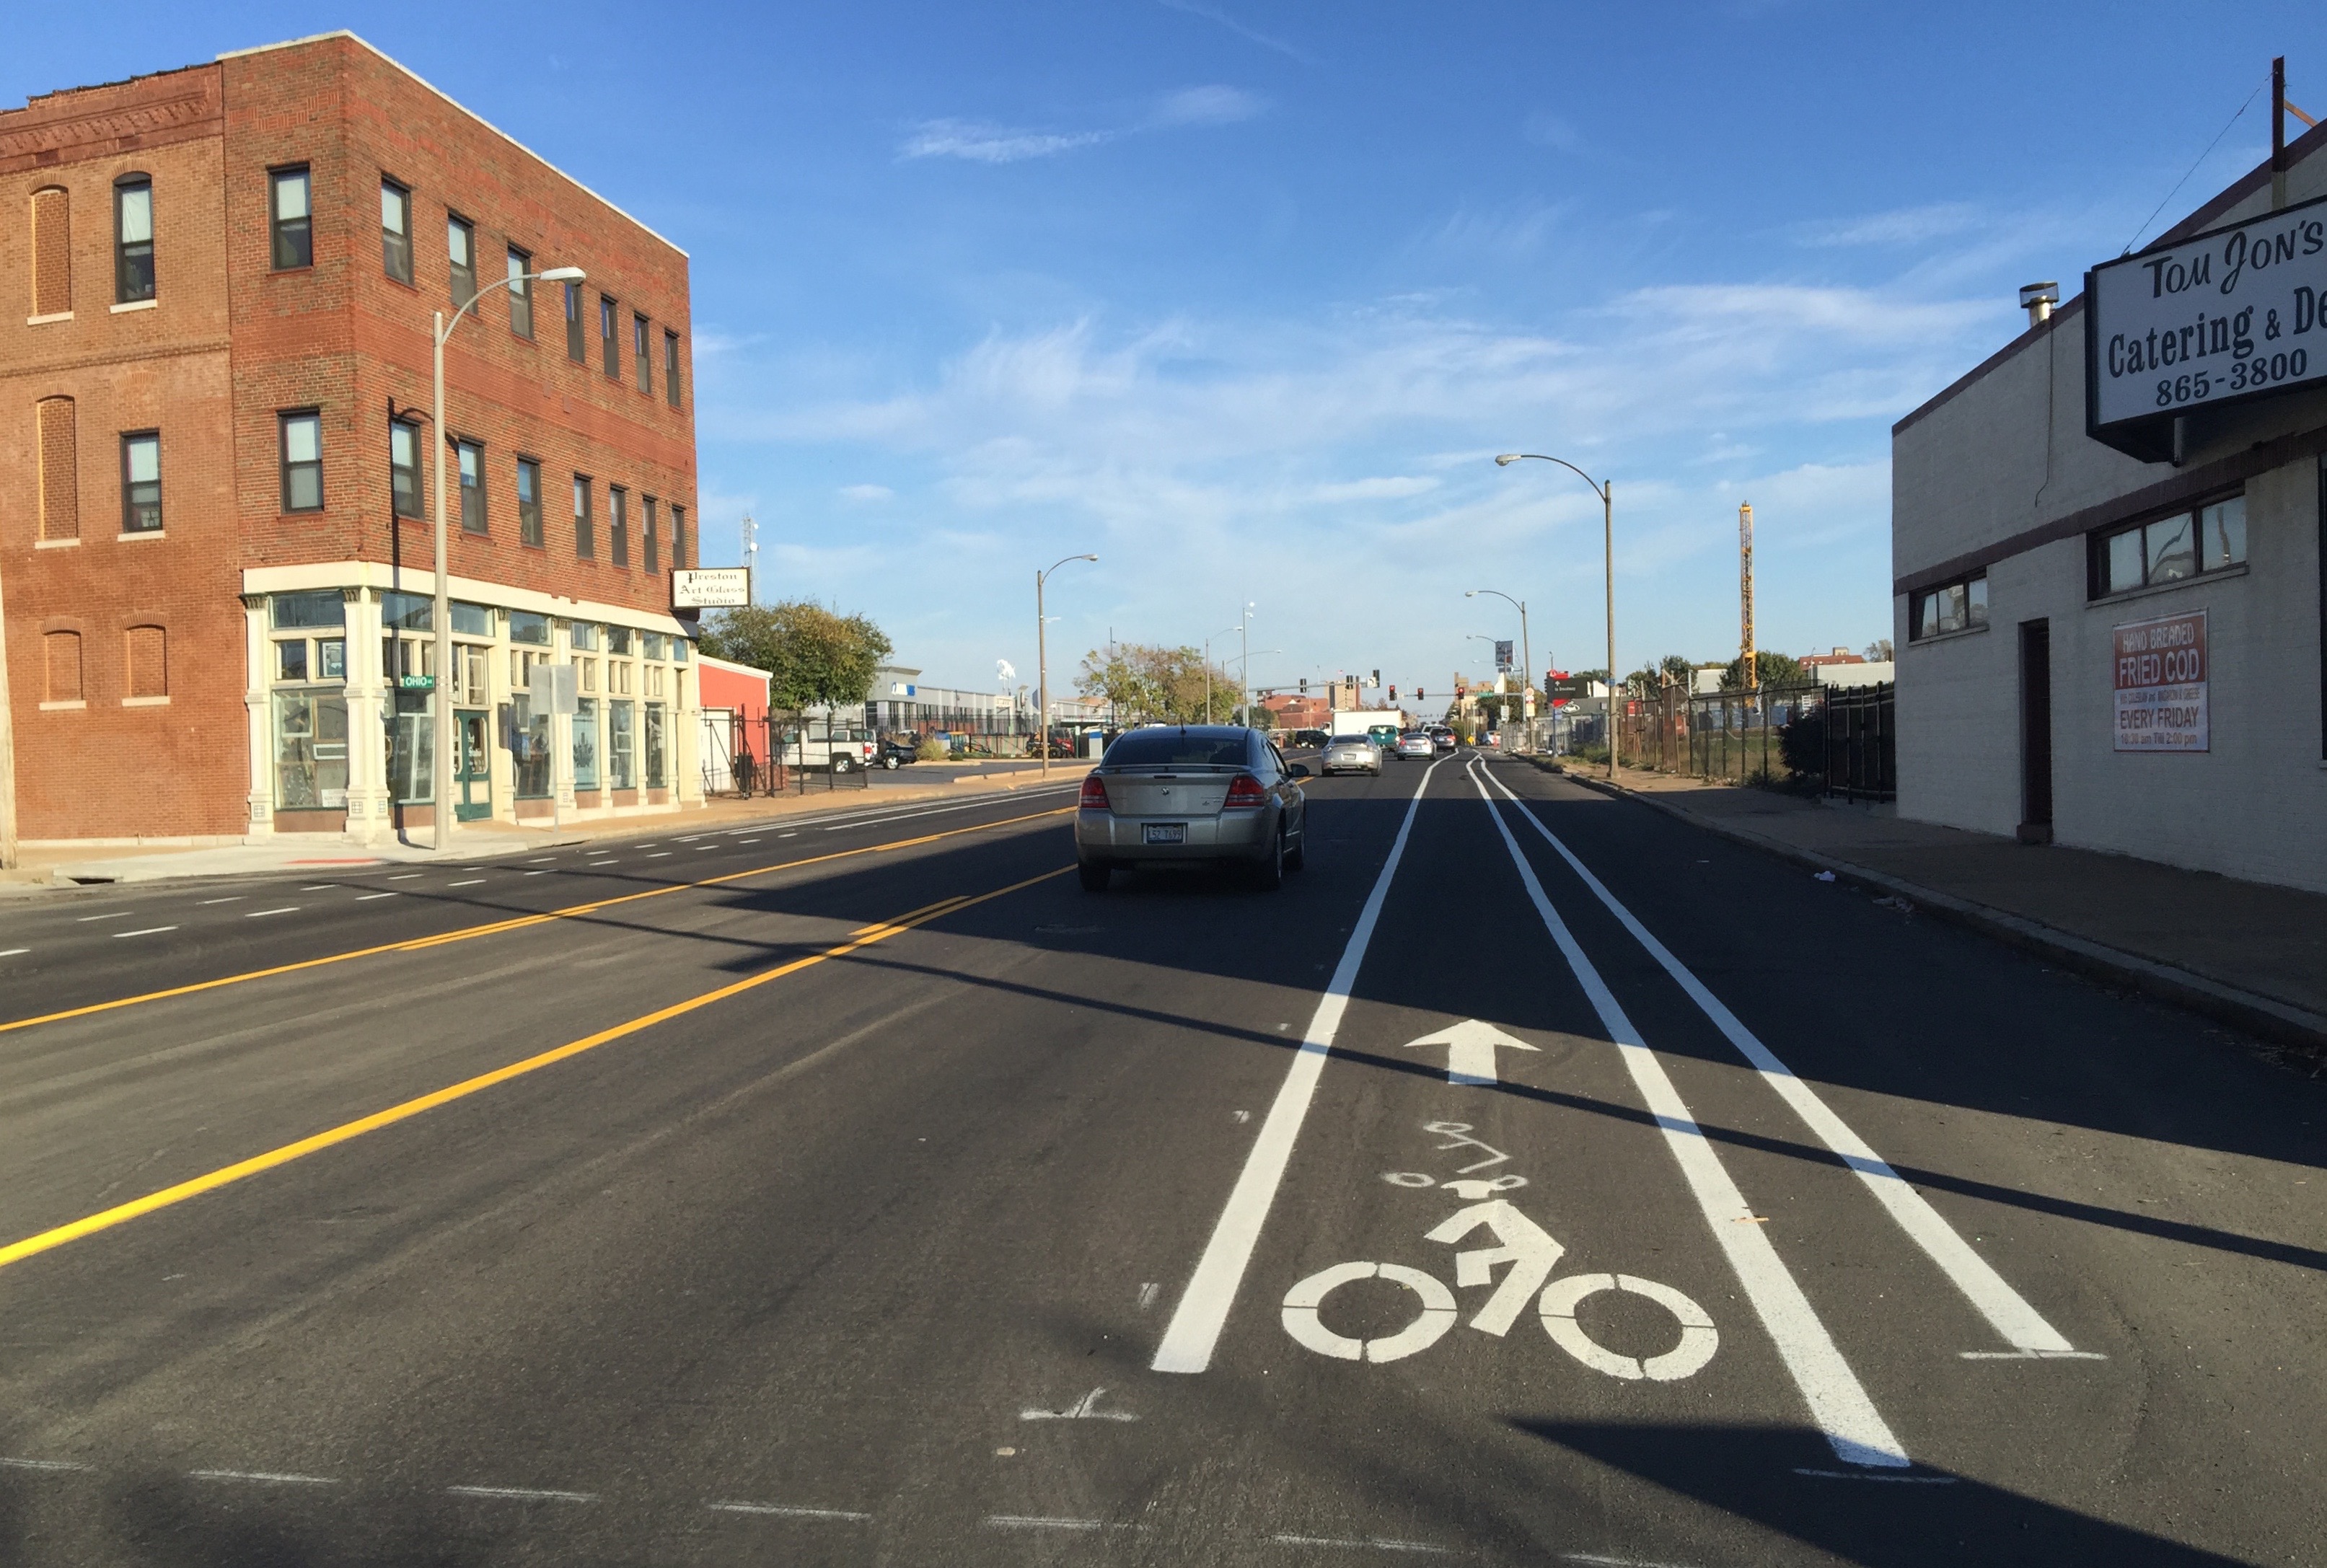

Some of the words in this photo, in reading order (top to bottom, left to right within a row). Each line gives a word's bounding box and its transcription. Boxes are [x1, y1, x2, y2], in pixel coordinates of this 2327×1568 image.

[2108, 304, 2255, 379] Catering
[2264, 308, 2282, 341] &
[2156, 348, 2308, 408] 865-3800
[679, 585, 701, 594] Art
[706, 584, 746, 594] Glass
[687, 571, 737, 583] Preston
[690, 596, 735, 605] Studio
[2122, 629, 2147, 653] HAND
[2150, 622, 2194, 649] BREADED
[2119, 653, 2161, 687] FRIED
[2165, 648, 2200, 682] COD
[405, 677, 427, 687] OHIO
[2120, 708, 2155, 730] EVERY
[2157, 706, 2199, 728] FRIDAY
